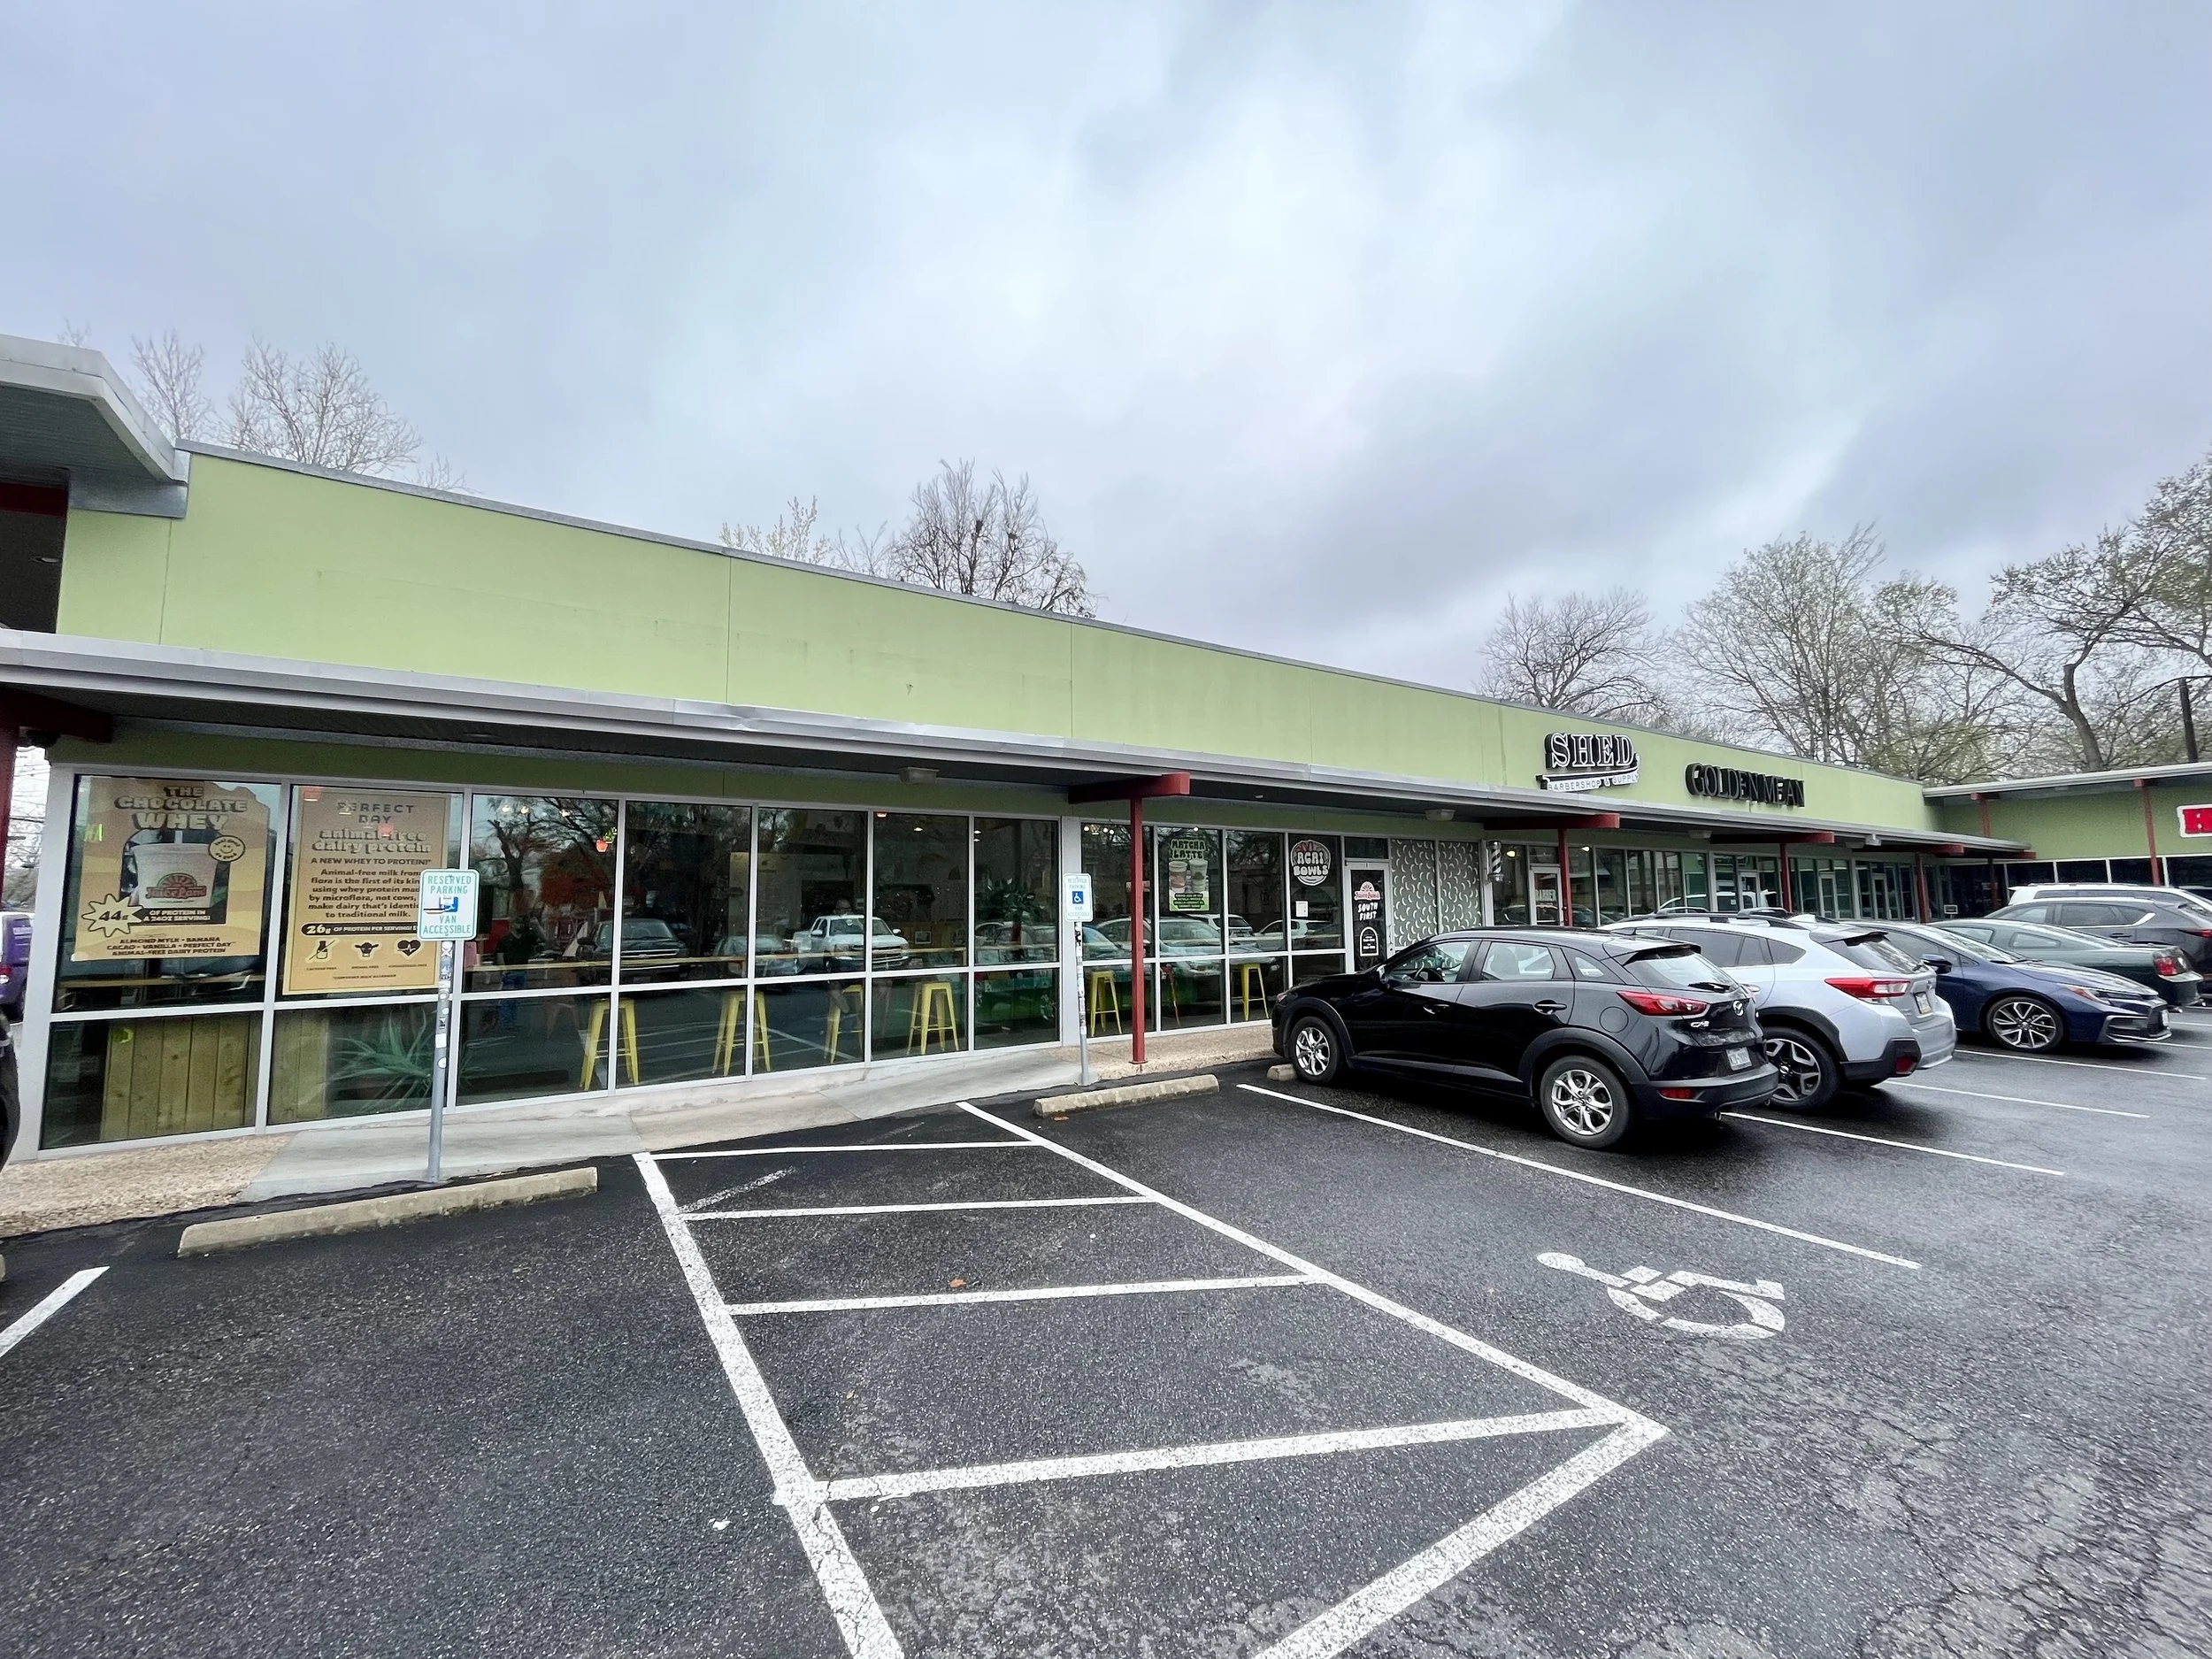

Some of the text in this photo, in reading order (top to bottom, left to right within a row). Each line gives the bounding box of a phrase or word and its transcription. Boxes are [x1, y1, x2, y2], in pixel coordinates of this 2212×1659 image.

[1545, 733, 1634, 769] SHED
[1548, 780, 1601, 792] BARBERSHOP
[1612, 773, 1640, 784] SUPPLY
[1686, 763, 1805, 807] GOLDEN MEAN
[164, 787, 204, 797] THE
[114, 796, 248, 812] CHOCOLATE
[338, 802, 414, 813] PERFECT
[133, 812, 228, 831] WHEY
[358, 815, 392, 824] DAY
[312, 840, 432, 855] dairy protein
[1171, 840, 1206, 850] MATCHA
[1173, 849, 1204, 859] LATTE
[1293, 865, 1329, 876] BOWLS
[427, 875, 472, 885] RESERVED
[430, 885, 468, 895] PARKING
[1357, 902, 1379, 913] SOUTH
[439, 915, 457, 925] VAN
[1359, 911, 1377, 921] FIRST
[423, 925, 472, 934] ACCESSIBLE
